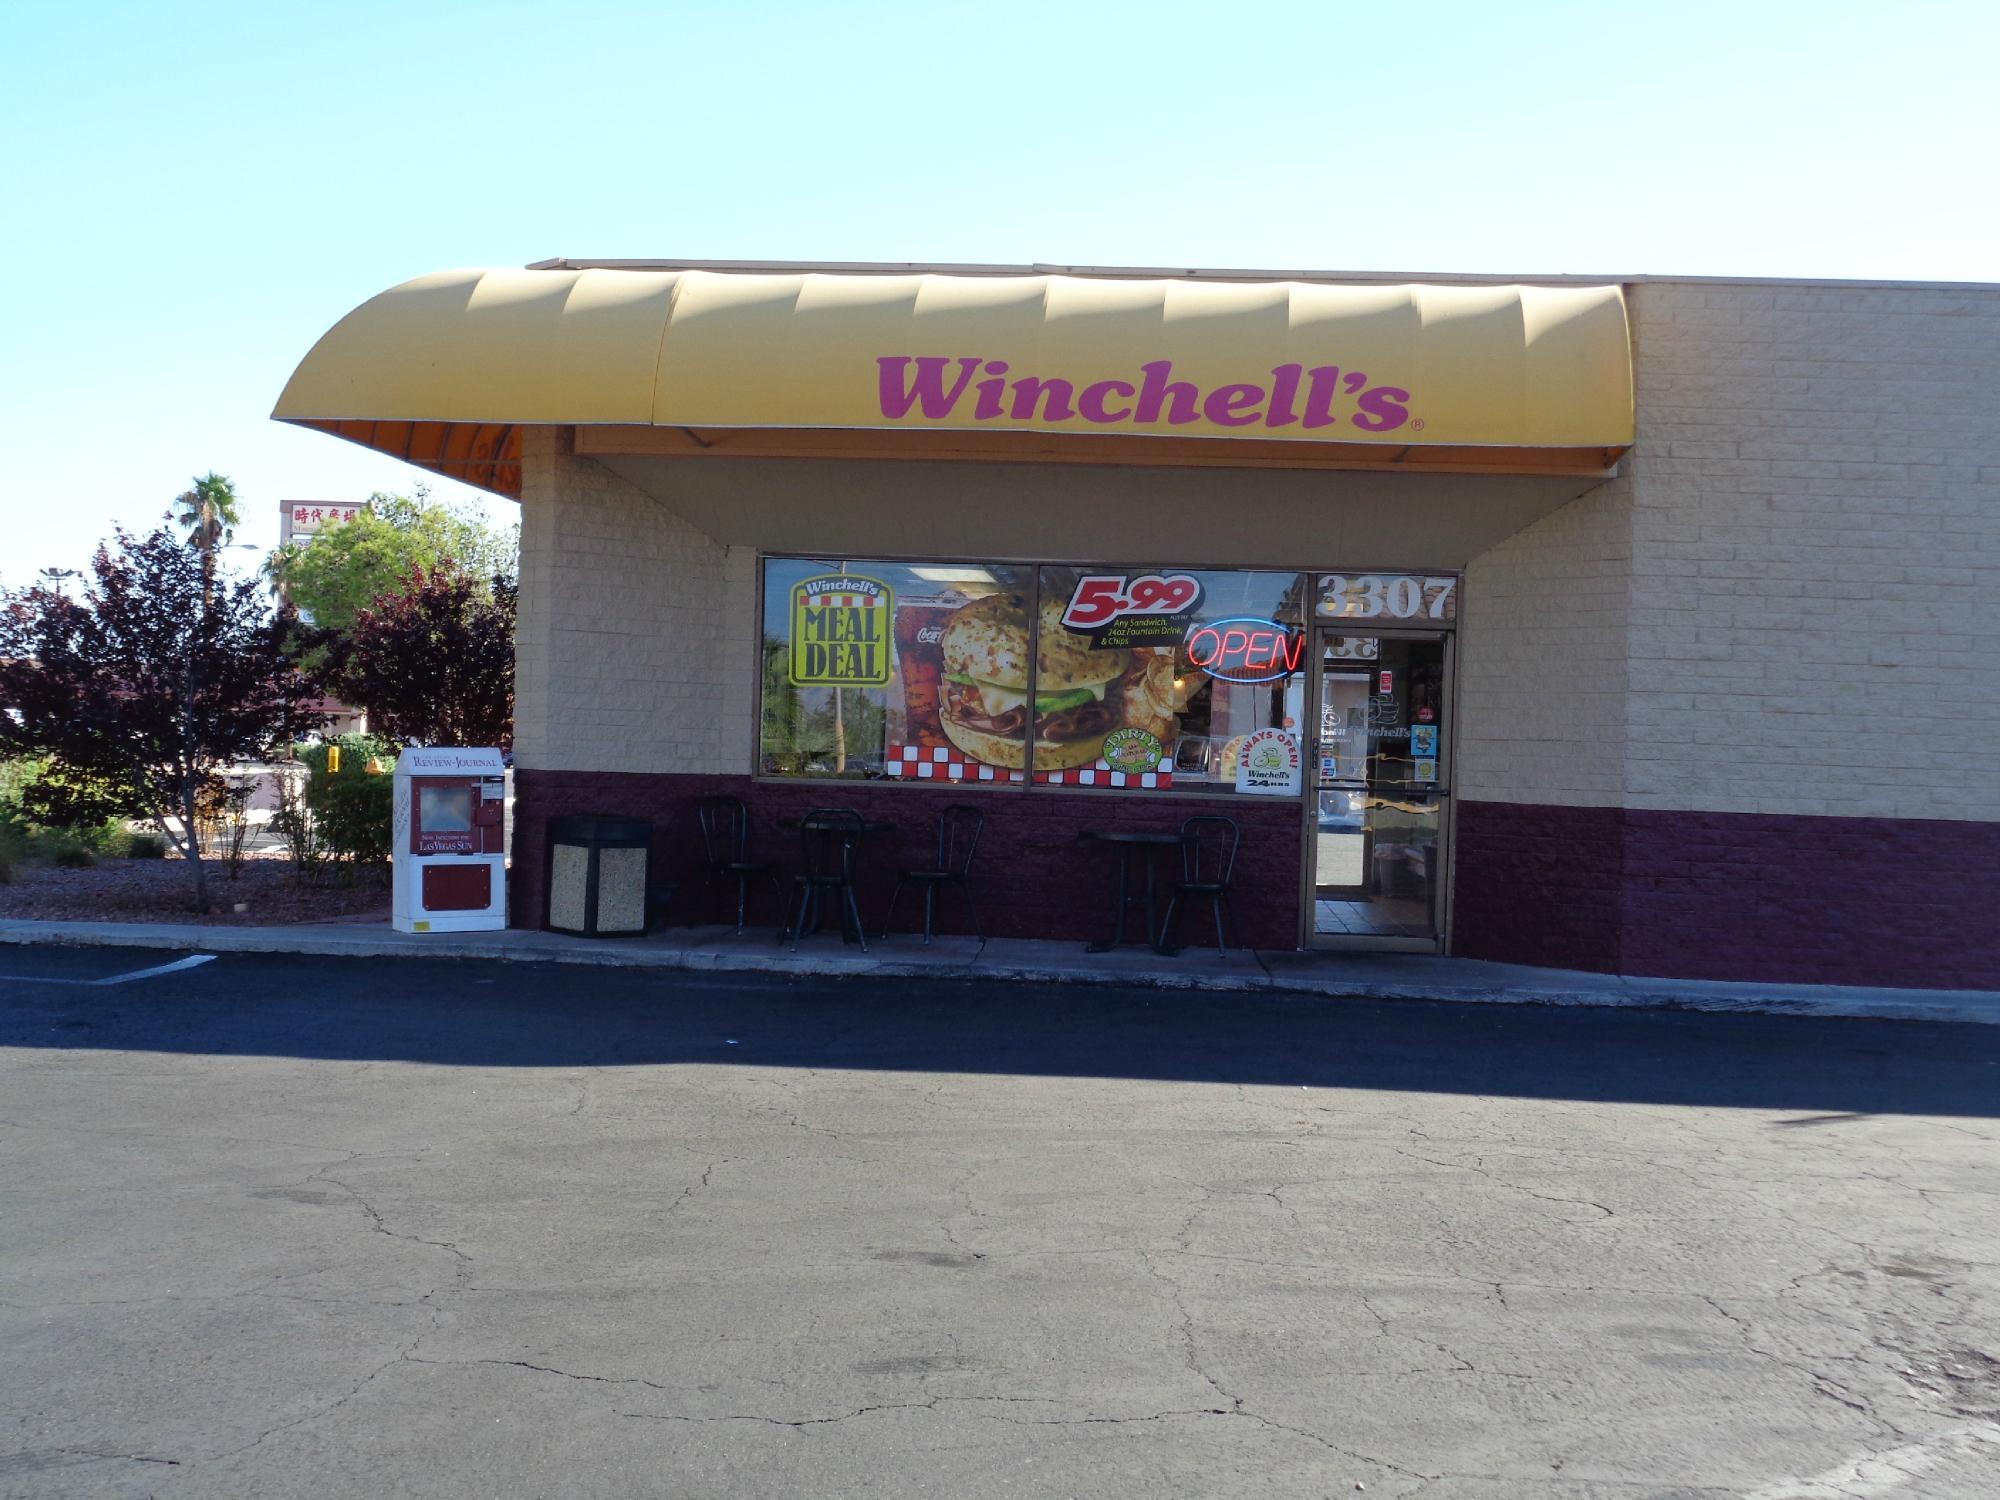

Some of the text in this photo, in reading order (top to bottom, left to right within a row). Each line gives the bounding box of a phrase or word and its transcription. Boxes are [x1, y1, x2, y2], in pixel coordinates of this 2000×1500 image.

[876, 356, 1410, 432] Winchell's
[805, 578, 881, 596] Winchell's
[1316, 575, 1456, 618] 3307
[803, 607, 880, 642] MEAL
[1114, 619, 1128, 628] Any
[1127, 628, 1160, 637] Fountain
[1108, 637, 1129, 646] Chips
[1187, 628, 1303, 671] OPEN
[804, 643, 880, 678] DEAL
[1240, 731, 1273, 768] ALWAYS
[1277, 734, 1298, 769] OPEN!
[1248, 770, 1290, 779] Winchell's
